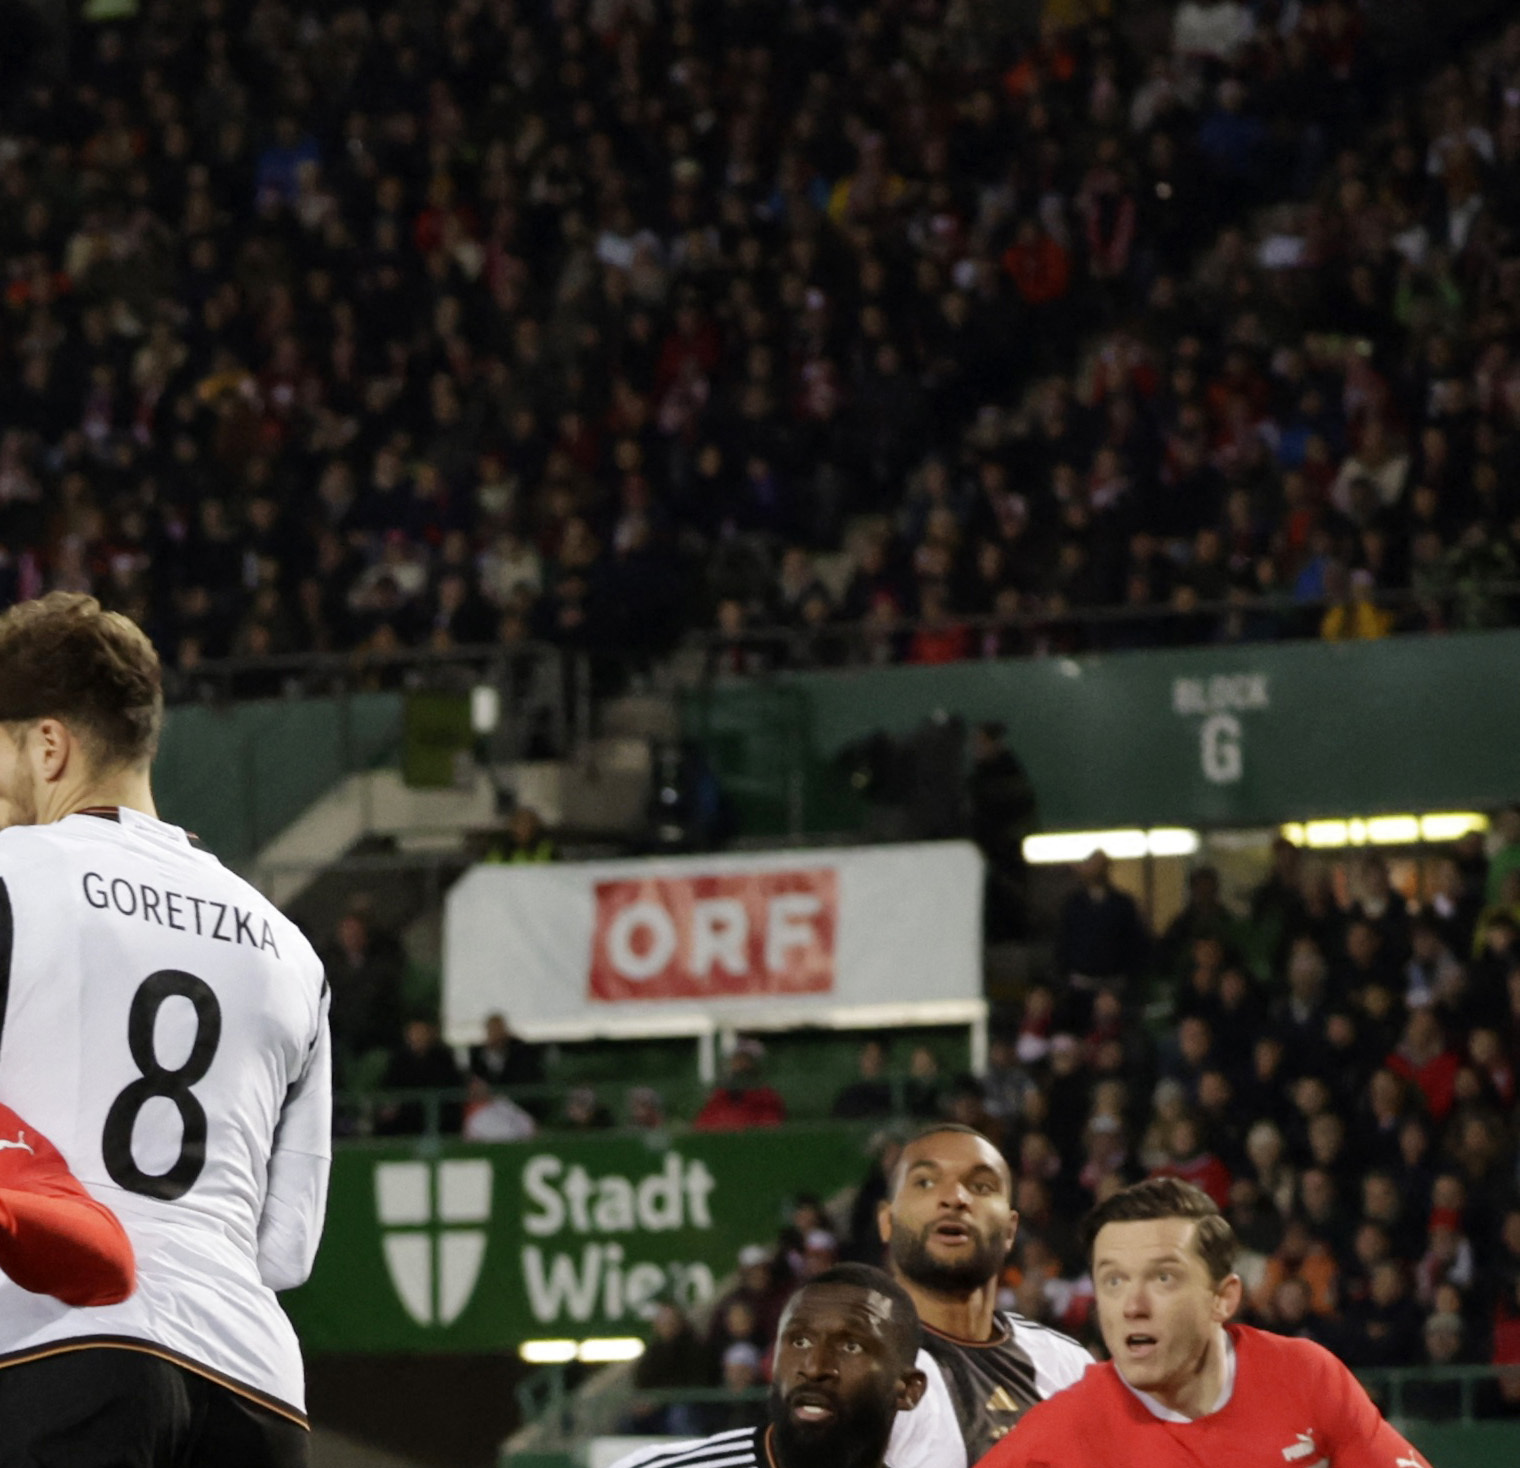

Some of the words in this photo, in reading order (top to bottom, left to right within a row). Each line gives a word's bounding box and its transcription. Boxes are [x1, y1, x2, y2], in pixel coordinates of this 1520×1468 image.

[1201, 715, 1243, 781] G
[82, 871, 281, 960] GORETZKA
[605, 893, 822, 984] ORF
[102, 969, 222, 1201] 8
[523, 1152, 715, 1237] Stadt
[523, 1243, 715, 1323] Wien
